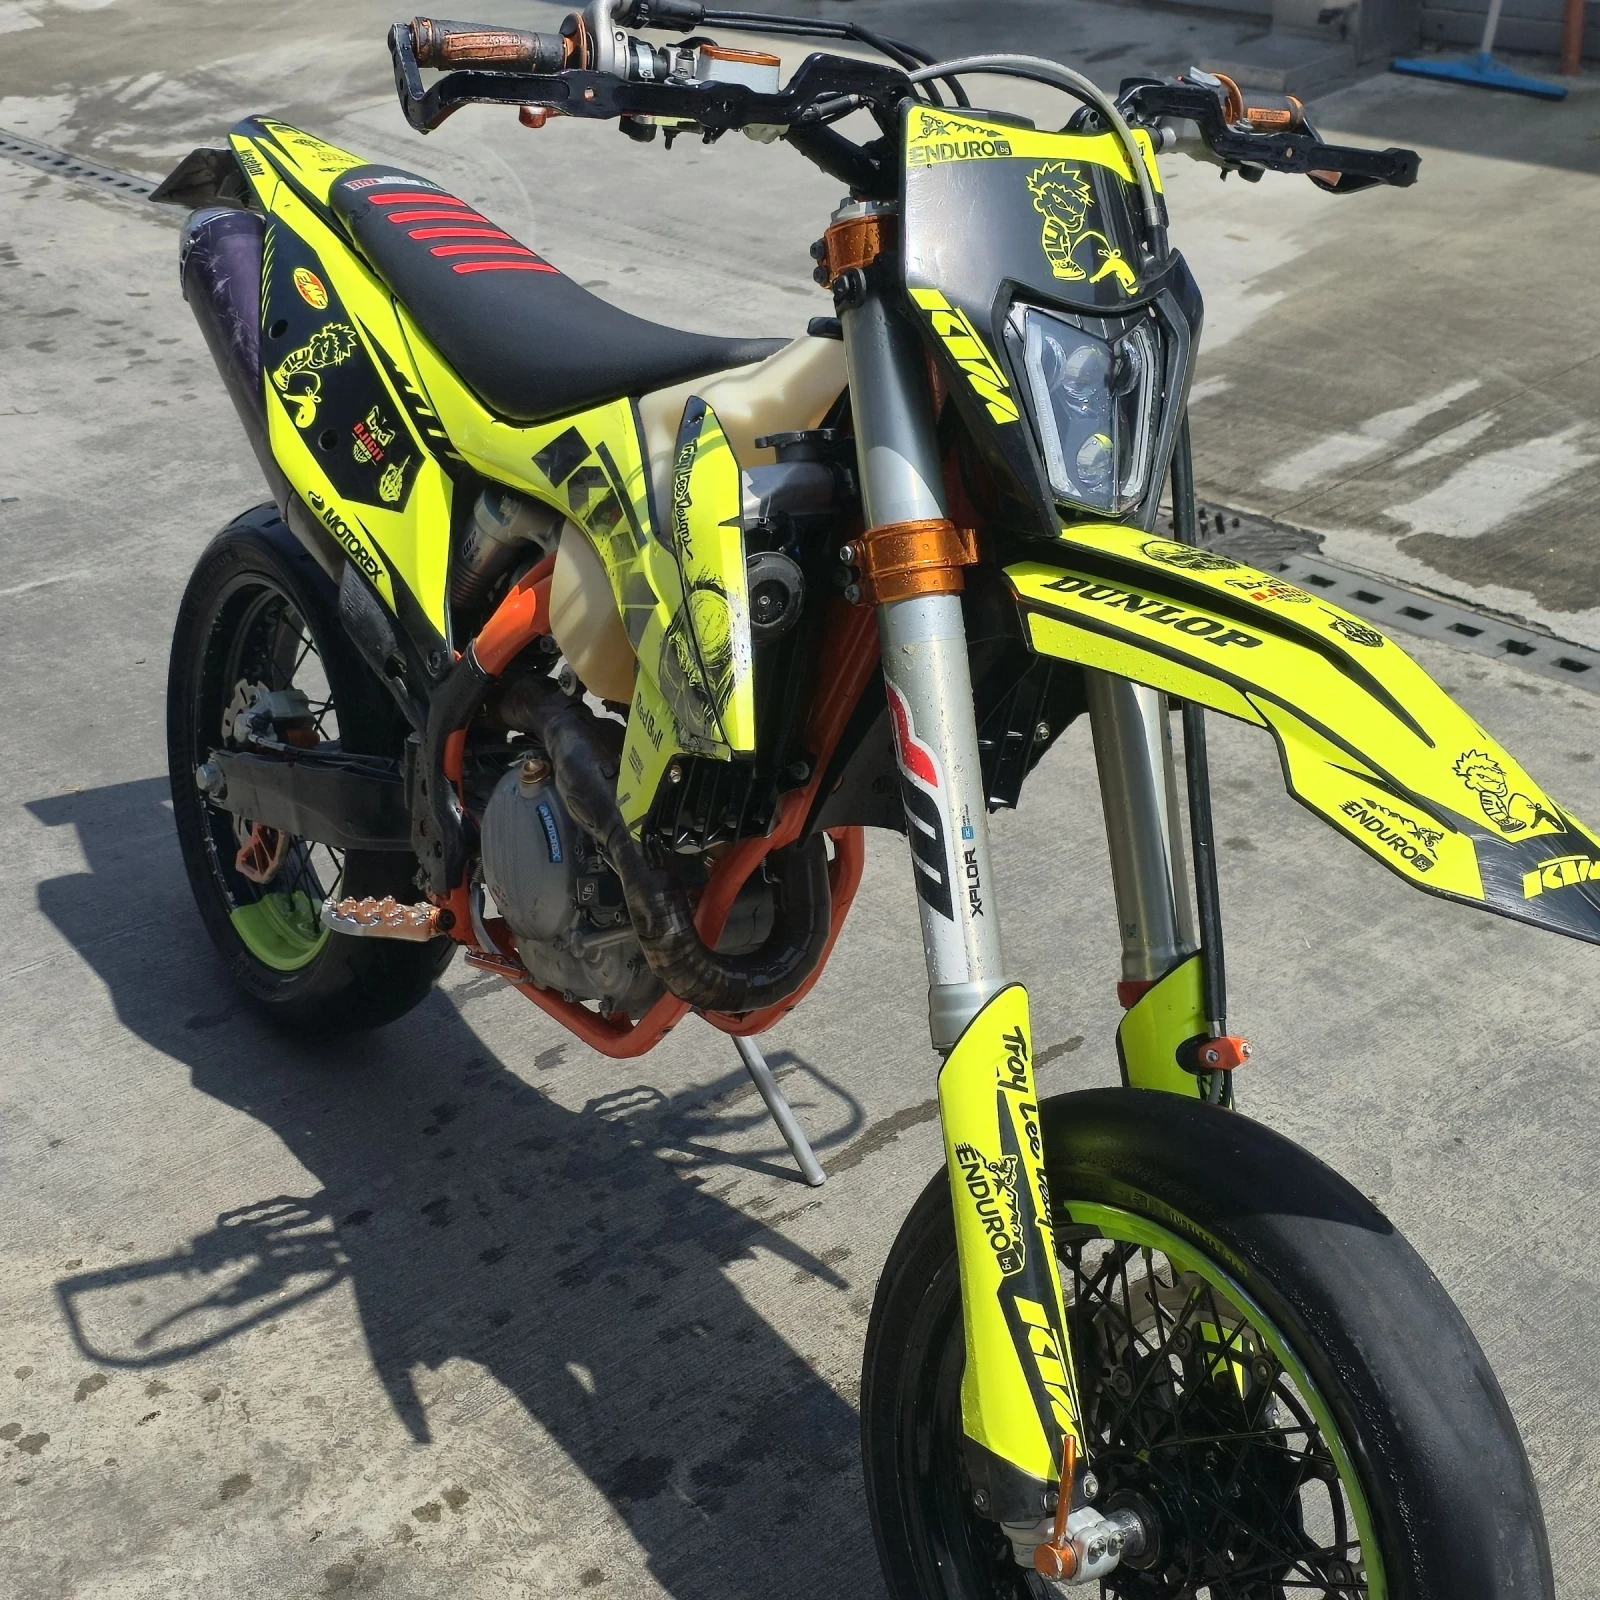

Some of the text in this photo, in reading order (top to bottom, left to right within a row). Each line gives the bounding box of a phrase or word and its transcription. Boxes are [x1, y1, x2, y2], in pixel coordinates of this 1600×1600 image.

[909, 141, 996, 163] ENDURO
[908, 288, 1020, 425] KTM
[322, 507, 383, 583] MOTOREX
[1040, 575, 1263, 649] DUNLOP
[634, 691, 650, 728] Red
[647, 717, 665, 753] Bull
[541, 812, 562, 860] MOTOREX
[1340, 800, 1419, 861] ENDURO
[964, 847, 984, 918] XPLOR
[999, 1025, 1029, 1094] Troy
[1018, 1102, 1042, 1160] Lee
[955, 1142, 1011, 1252] ENDURO
[1013, 1295, 1085, 1458] KTM
